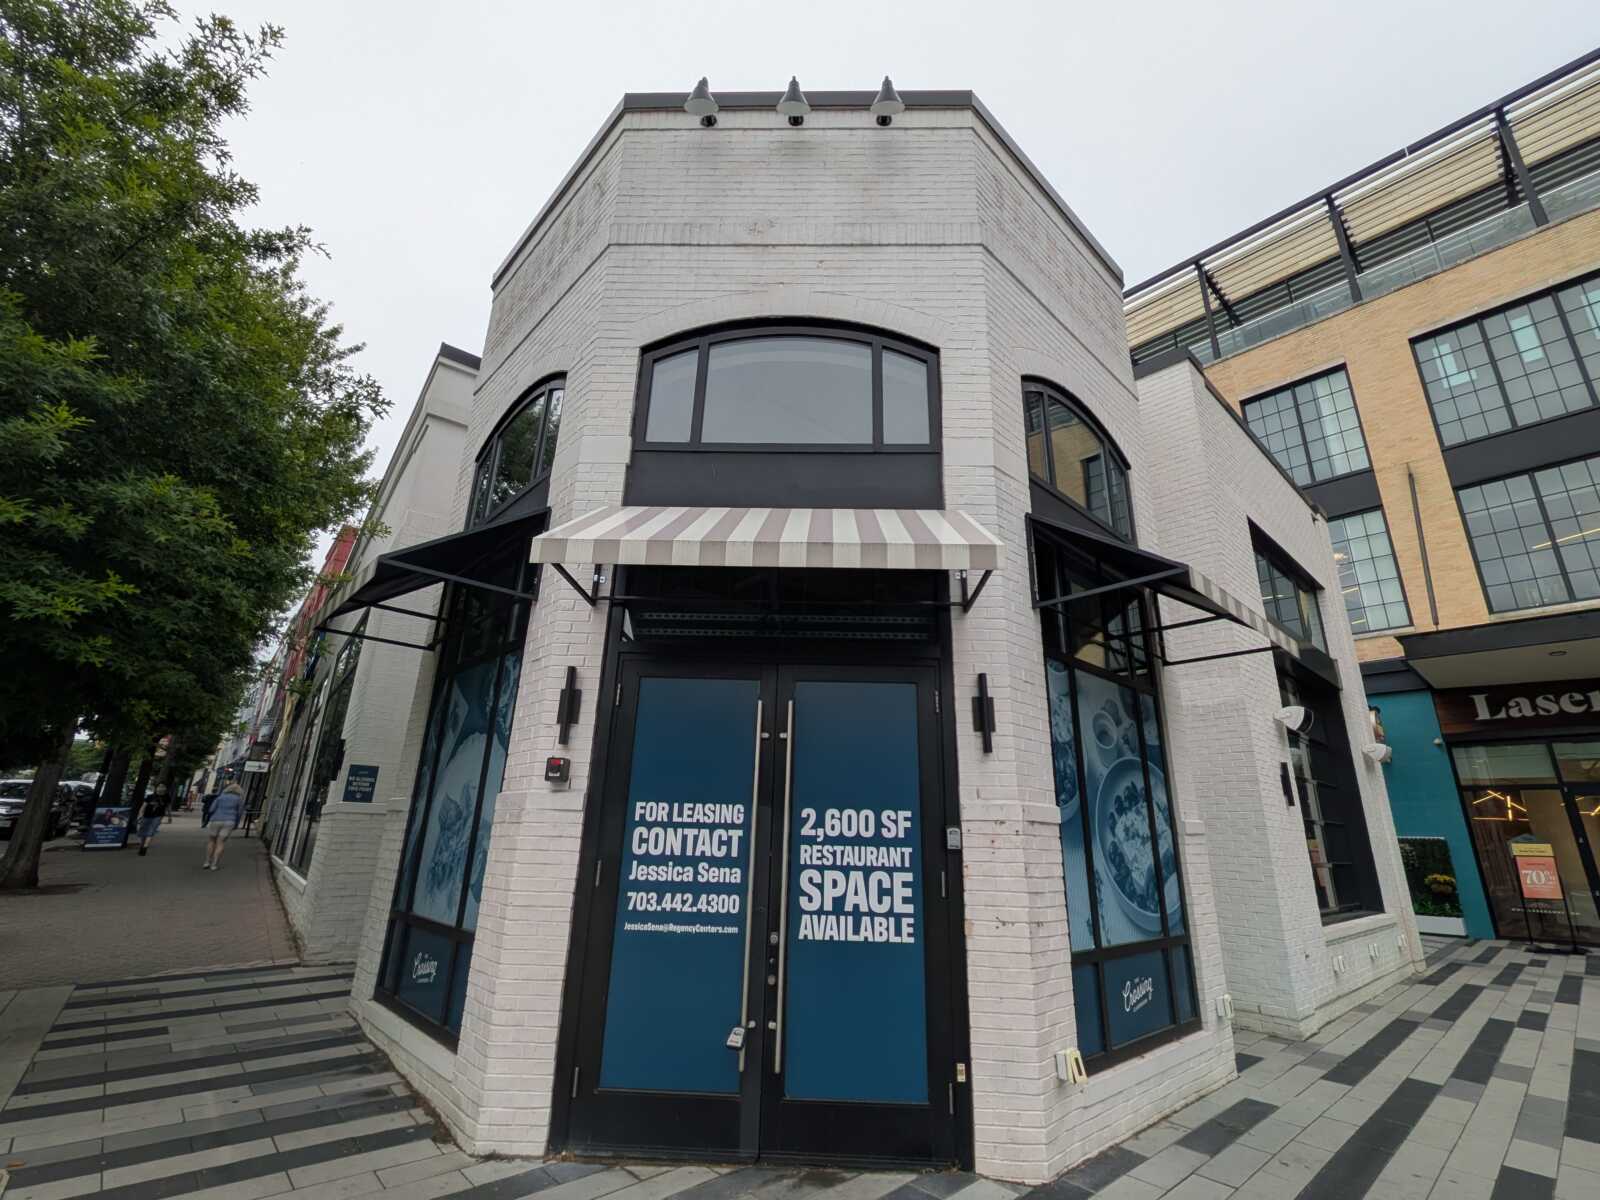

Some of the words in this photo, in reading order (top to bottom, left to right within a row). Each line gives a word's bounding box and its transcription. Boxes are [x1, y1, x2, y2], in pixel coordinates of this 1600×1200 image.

[634, 801, 670, 822] FOR
[672, 802, 745, 825] LEASING
[800, 807, 876, 842] 2,600
[880, 809, 912, 839] SF
[631, 826, 744, 858] CONTACT
[799, 844, 913, 868] RESTAURANT
[628, 860, 694, 883] Jessica
[697, 861, 742, 884] Sena
[627, 891, 740, 914] 703.442.4300
[799, 868, 915, 914] SPACE
[798, 914, 915, 944] AVAILABLE
